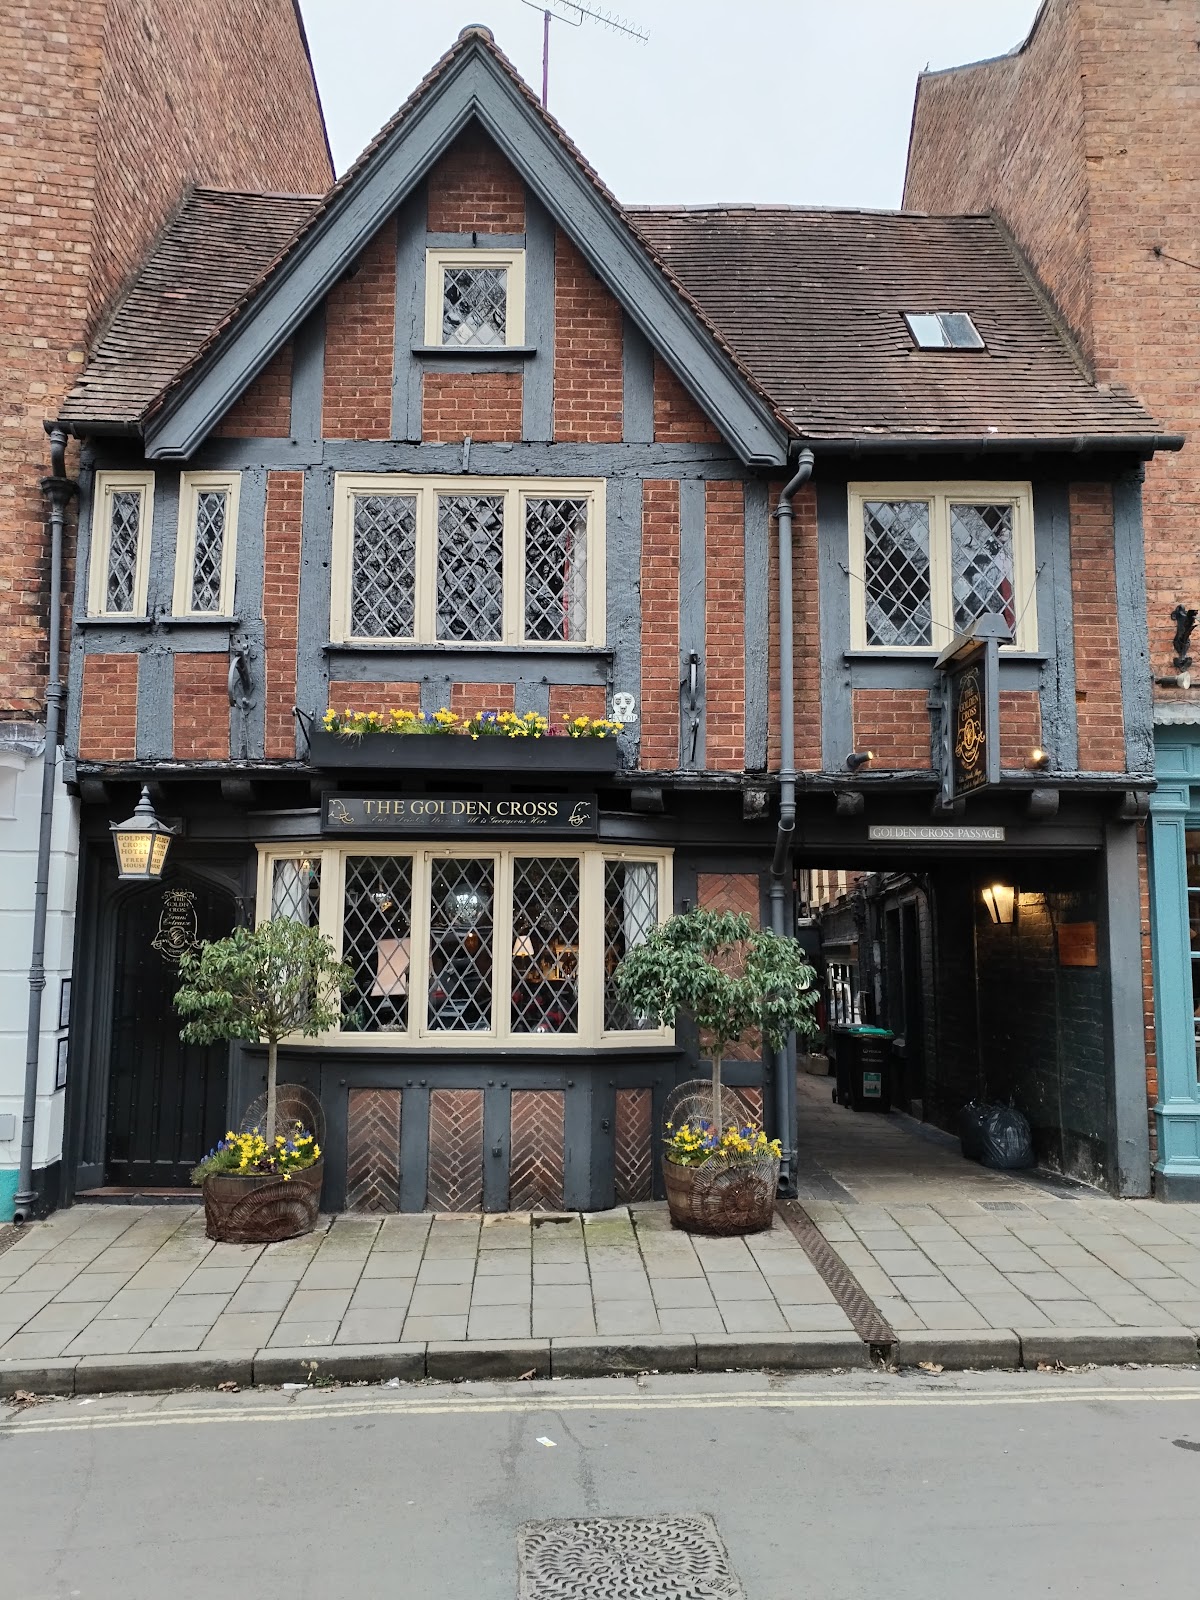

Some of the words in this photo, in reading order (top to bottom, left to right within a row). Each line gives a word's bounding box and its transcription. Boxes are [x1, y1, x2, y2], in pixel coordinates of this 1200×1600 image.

[959, 694, 979, 713] GOLDEN
[961, 705, 977, 721] CROSS
[363, 800, 405, 815] THE
[410, 800, 492, 815] GOLDEN
[496, 801, 559, 816] CROSS
[873, 827, 917, 838] GOLDEN
[920, 827, 954, 839] CROSS
[957, 828, 1001, 839] PASSAGE
